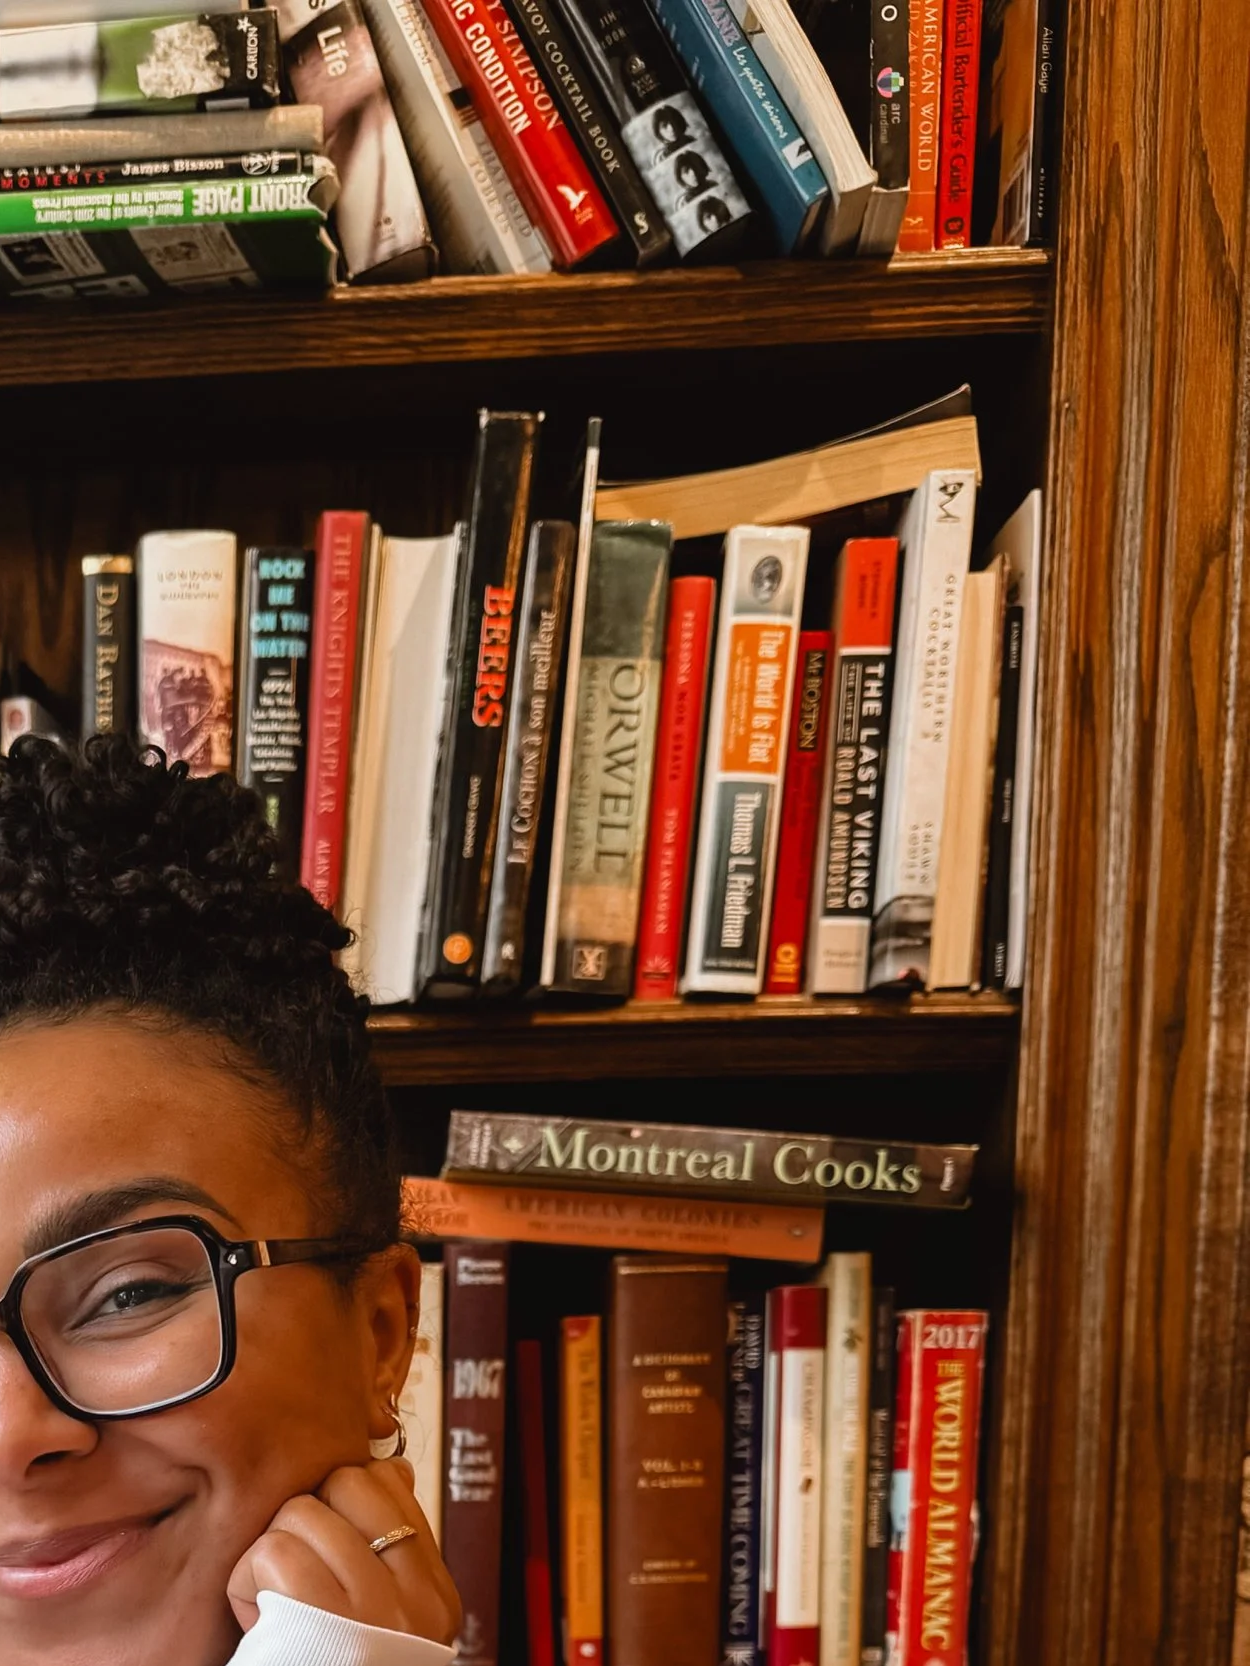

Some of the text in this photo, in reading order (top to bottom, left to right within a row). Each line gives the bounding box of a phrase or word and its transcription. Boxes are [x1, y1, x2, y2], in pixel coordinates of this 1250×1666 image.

[317, 26, 350, 77] Life
[1042, 27, 1053, 60] Allan
[465, 23, 531, 136] CONDITION
[495, 19, 564, 132] SIMPSON
[545, 41, 621, 173] COCKTAIL BOOK
[880, 104, 888, 144] cardinal
[891, 103, 900, 124] arc
[949, 54, 969, 202] Bartender's Guide
[121, 158, 224, 177] James Bisson
[918, 103, 935, 172] WORLD
[0, 170, 106, 190] MOMENTS
[191, 186, 243, 216] PAGE
[35, 203, 184, 224] Major Events of the 20th Century
[258, 558, 305, 580] ROCK
[333, 532, 351, 578] THE
[96, 583, 120, 636] DAN
[250, 612, 309, 632] ON THE
[268, 585, 295, 605] ME
[250, 637, 308, 658] WATER
[325, 590, 350, 698] KNIGHTS
[472, 584, 514, 729] BEERS
[681, 610, 696, 686] PERSONA
[922, 606, 940, 709] COCKTAILS
[932, 573, 956, 743] GREAT NORTHERN
[675, 691, 688, 724] NON
[747, 630, 786, 763] The World Is Flat
[797, 652, 823, 749] Mr BOSTON
[319, 704, 343, 815] TEMPLAR
[506, 609, 557, 865] LE COCHON à son meilleur
[569, 663, 599, 874] MICHAEL SHELDEN
[595, 664, 645, 874] ORWELL
[847, 662, 885, 909] THE LAST VIKING
[729, 791, 763, 856] Thomas
[826, 745, 857, 909] ROALD AMUNDSEN
[919, 821, 933, 884] SHAWN
[314, 839, 331, 875] ALAN
[654, 808, 679, 934] TOM FLANAGAN
[727, 858, 756, 873] L.
[720, 874, 756, 948] Friedman
[534, 1126, 754, 1184] Montreal
[773, 1139, 923, 1195] Cooks
[504, 1196, 761, 1231] AMERICAN COLONIES
[748, 1313, 762, 1370] DAVID
[920, 1323, 981, 1350] 2017
[452, 1359, 502, 1398] 1967
[449, 1446, 493, 1465] Last
[450, 1427, 487, 1446] The
[449, 1465, 496, 1483] Good
[449, 1484, 493, 1502] Year
[729, 1382, 754, 1636] GREAT TIME COMING
[921, 1360, 965, 1652] THE WORLD ALMANAC
